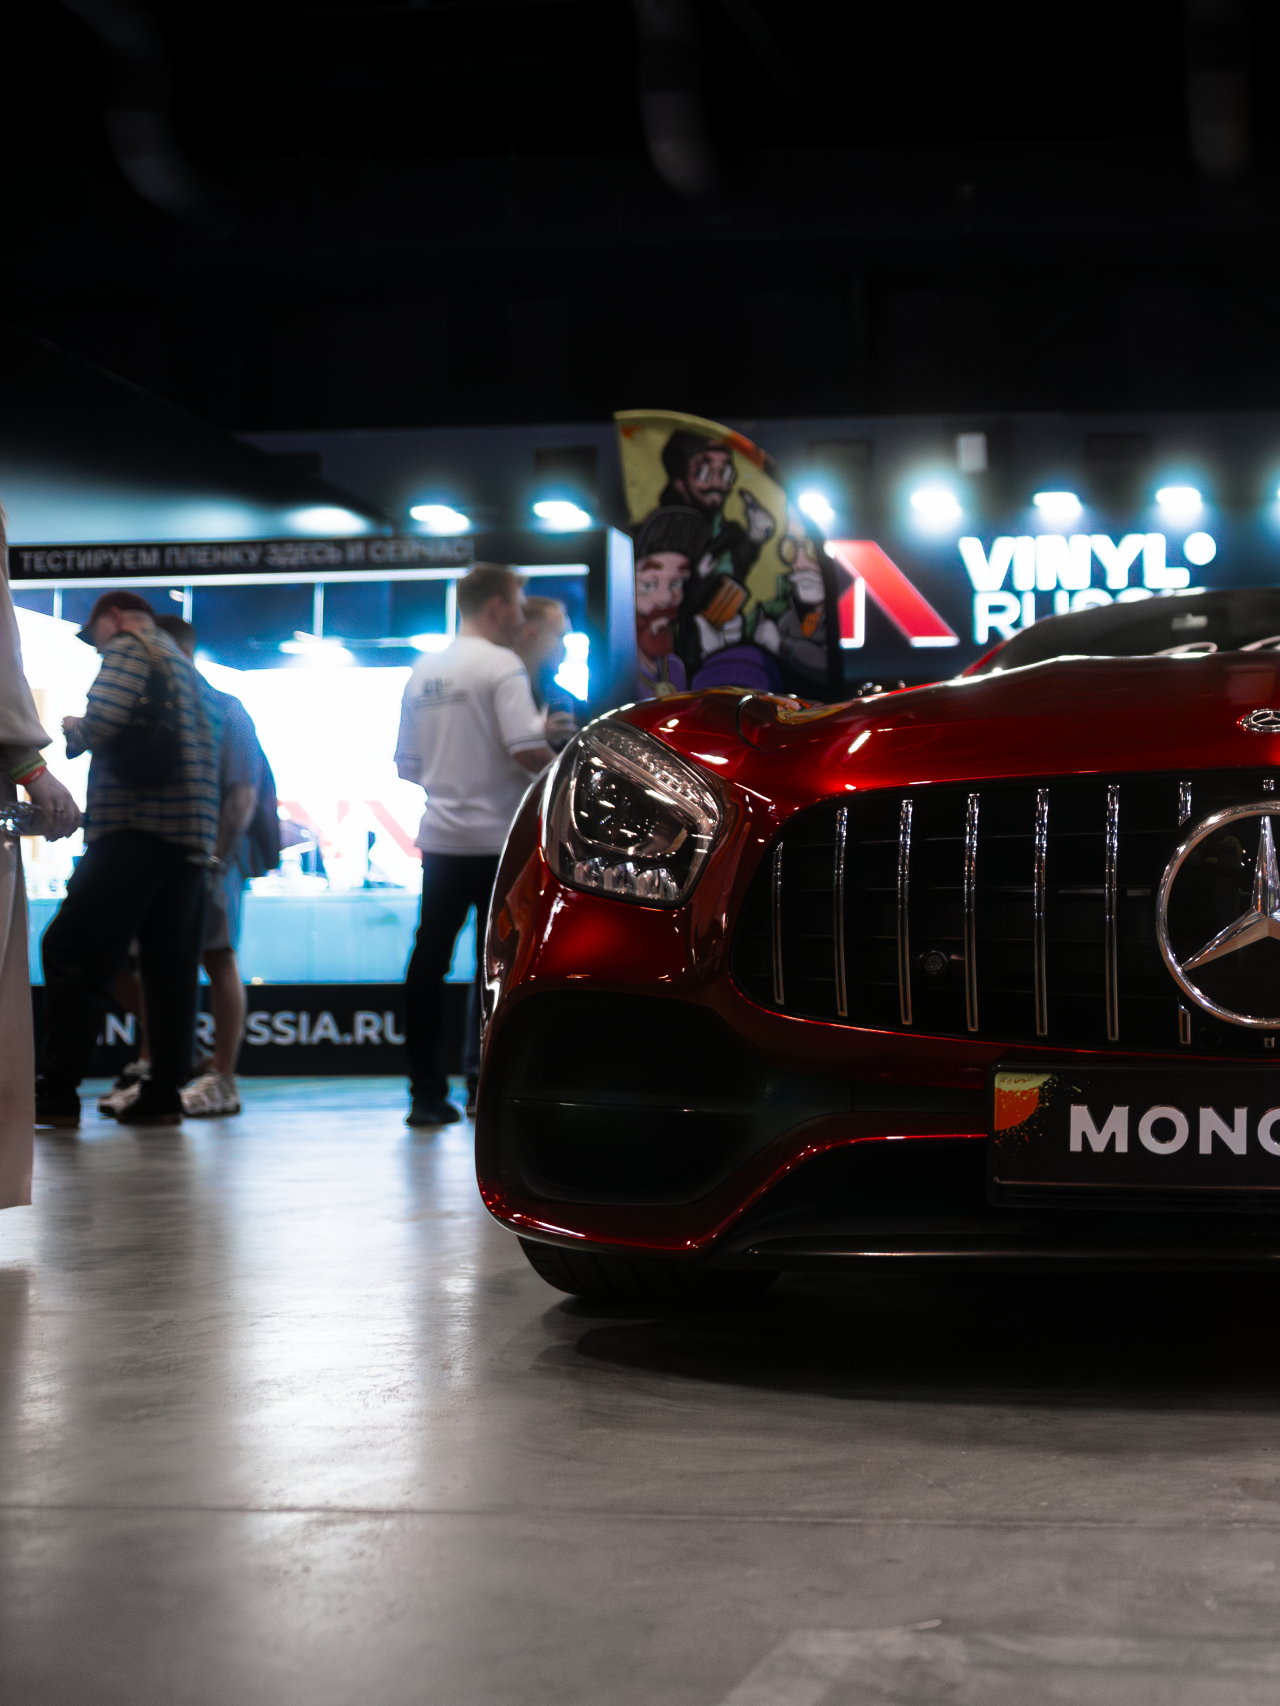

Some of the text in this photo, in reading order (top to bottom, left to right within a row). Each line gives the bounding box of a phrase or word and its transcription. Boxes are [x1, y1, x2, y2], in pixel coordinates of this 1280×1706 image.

[20, 548, 159, 573] ТЕСТИРУЕМ
[264, 542, 344, 569] ЗДЕСЬ
[345, 541, 365, 563] И
[957, 533, 1191, 592] VINYL
